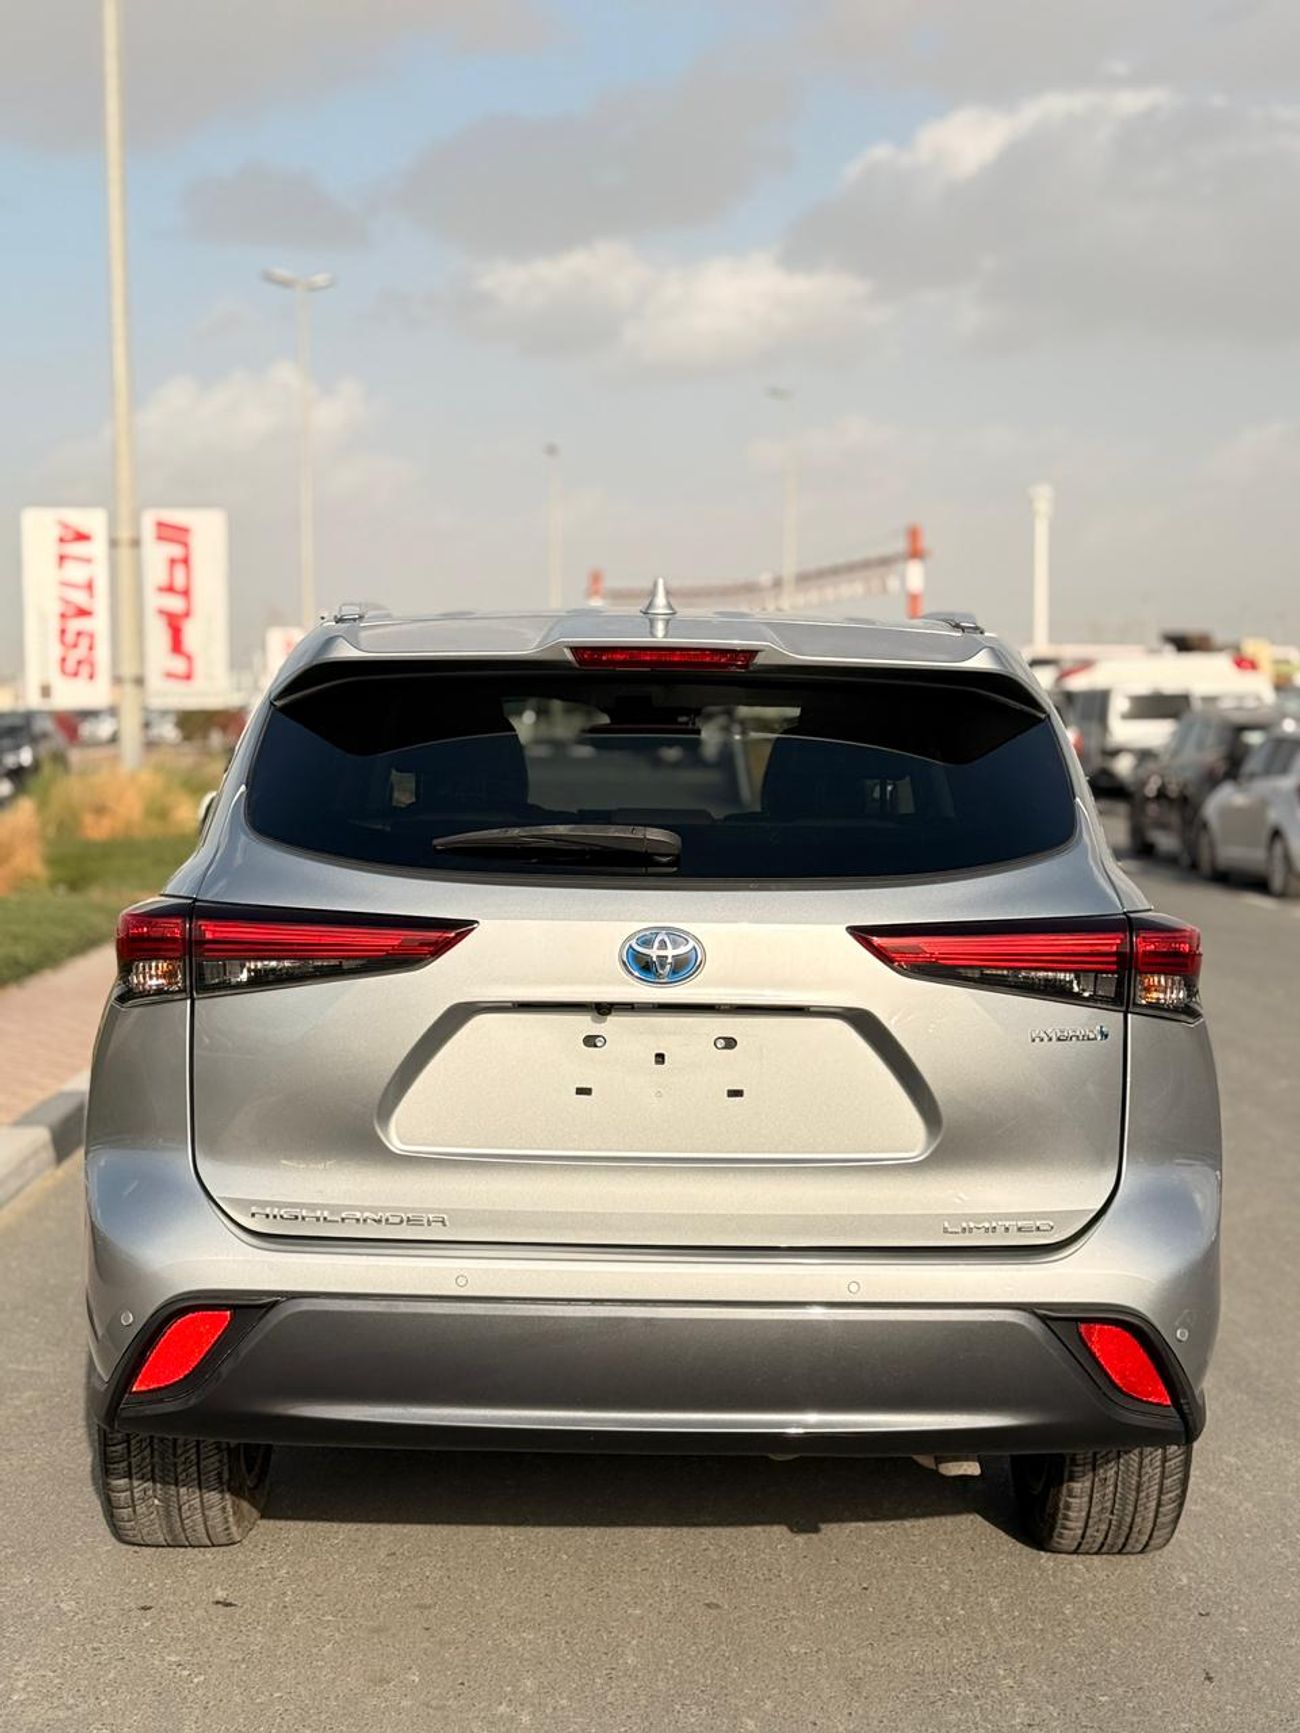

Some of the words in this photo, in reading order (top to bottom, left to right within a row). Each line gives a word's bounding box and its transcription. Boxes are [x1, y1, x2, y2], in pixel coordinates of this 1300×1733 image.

[56, 519, 95, 681] ALTASS
[1029, 1027, 1098, 1043] HYBRID
[250, 1206, 449, 1228] HIGHLANDER
[942, 1220, 1055, 1235] LIMITED
